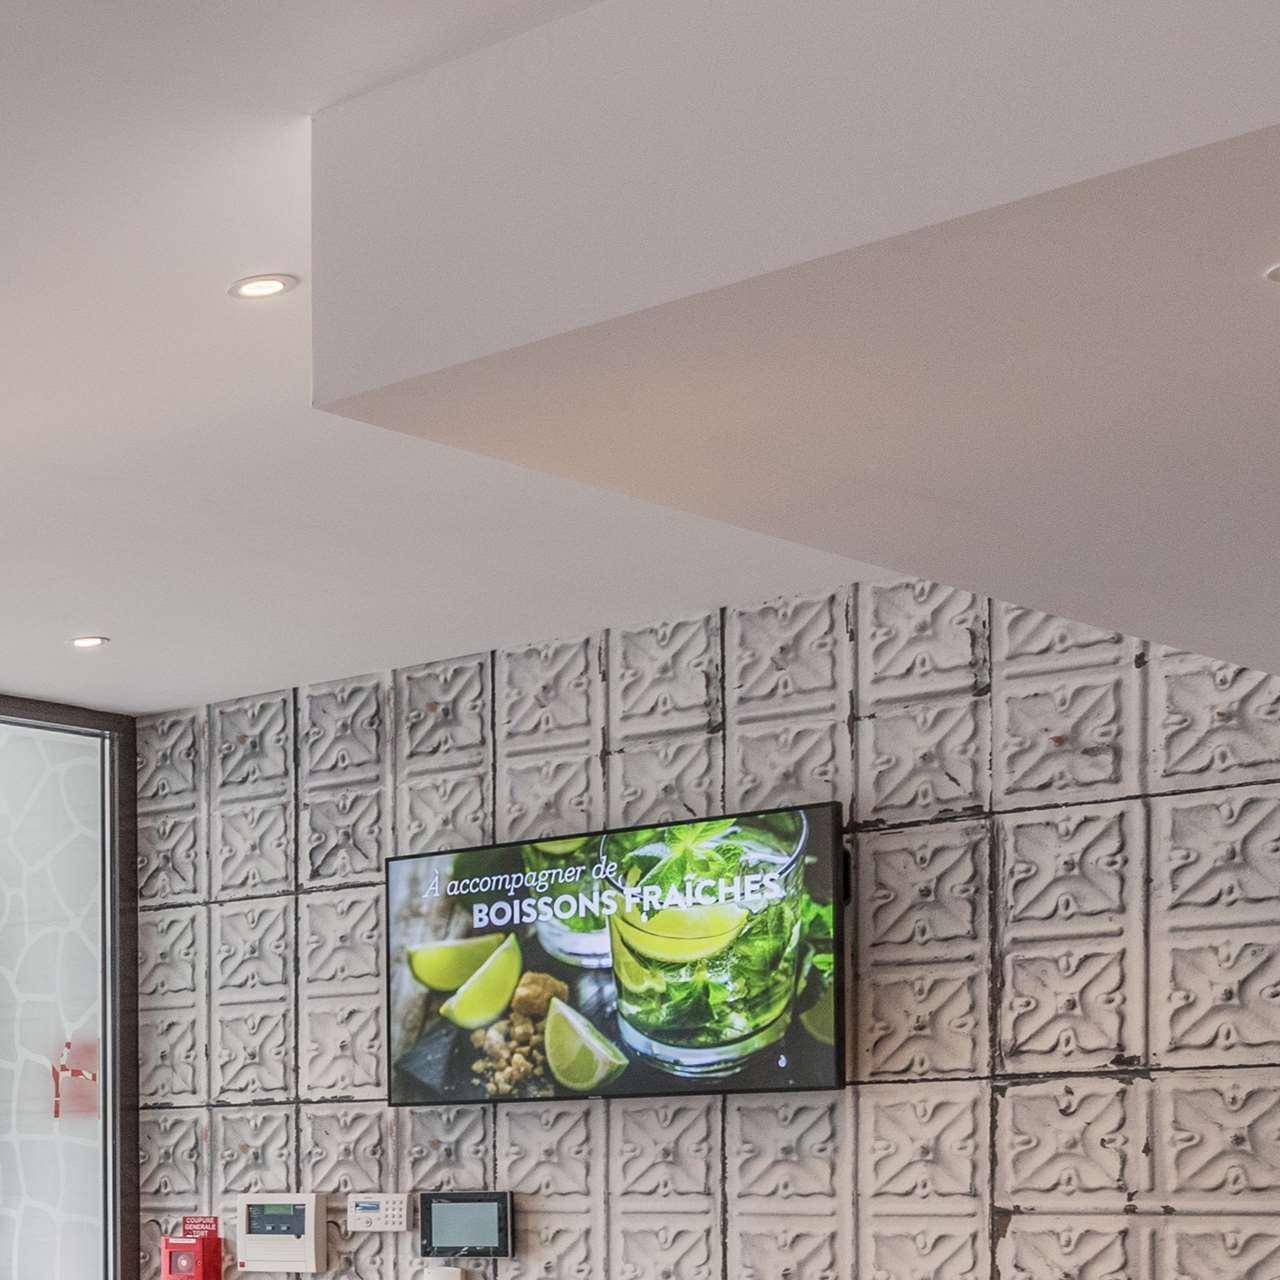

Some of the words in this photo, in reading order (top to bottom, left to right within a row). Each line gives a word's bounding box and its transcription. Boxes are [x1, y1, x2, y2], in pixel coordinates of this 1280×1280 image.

[422, 870, 441, 898] À
[446, 865, 586, 896] accompagner
[591, 856, 618, 879] de
[472, 890, 619, 929] BOISSONS
[624, 872, 783, 914] FRAÎCHES
